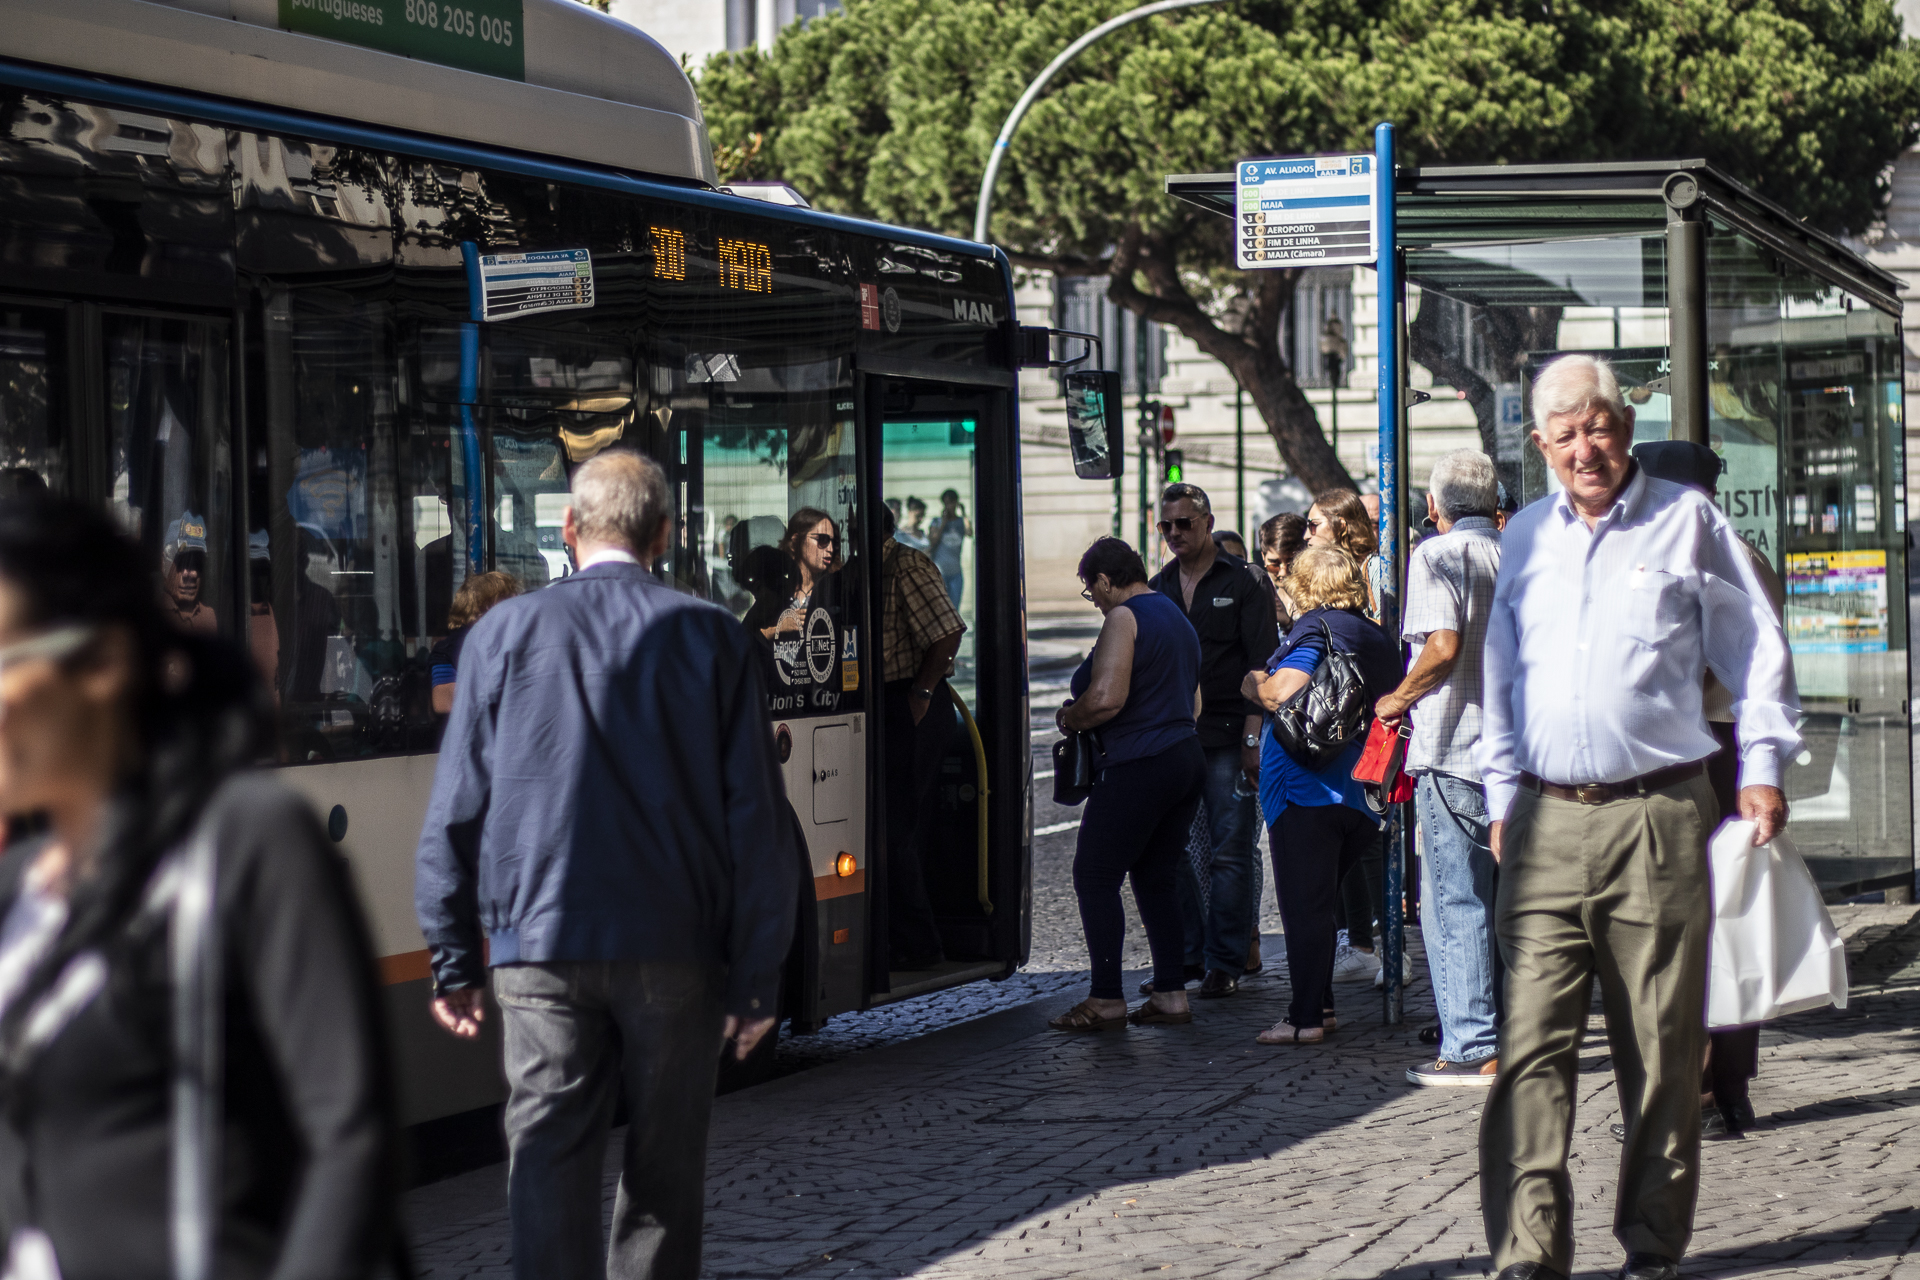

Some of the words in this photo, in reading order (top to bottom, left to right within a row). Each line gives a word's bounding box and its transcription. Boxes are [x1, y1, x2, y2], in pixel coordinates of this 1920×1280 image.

[291, 0, 384, 25] portugueses
[405, 0, 438, 28] 808
[443, 6, 475, 37] 205
[480, 15, 512, 46] 005
[1264, 167, 1277, 175] AV.
[1279, 165, 1314, 174] ALIADOS
[1351, 164, 1362, 174] C1
[1243, 189, 1258, 198] 600
[1278, 188, 1289, 196] DE
[1290, 187, 1315, 195] LINHA
[1261, 201, 1284, 209] MAIA
[1247, 215, 1253, 223] 3
[1267, 225, 1316, 234] AEROPORTO
[1247, 240, 1253, 248] 4
[1267, 239, 1281, 247] FIM
[1283, 238, 1294, 246] DE
[1295, 237, 1320, 245] LINHA
[1267, 251, 1289, 259] MAIA
[719, 238, 772, 293] MAIA
[953, 299, 994, 324] MAN
[811, 688, 841, 711] City
